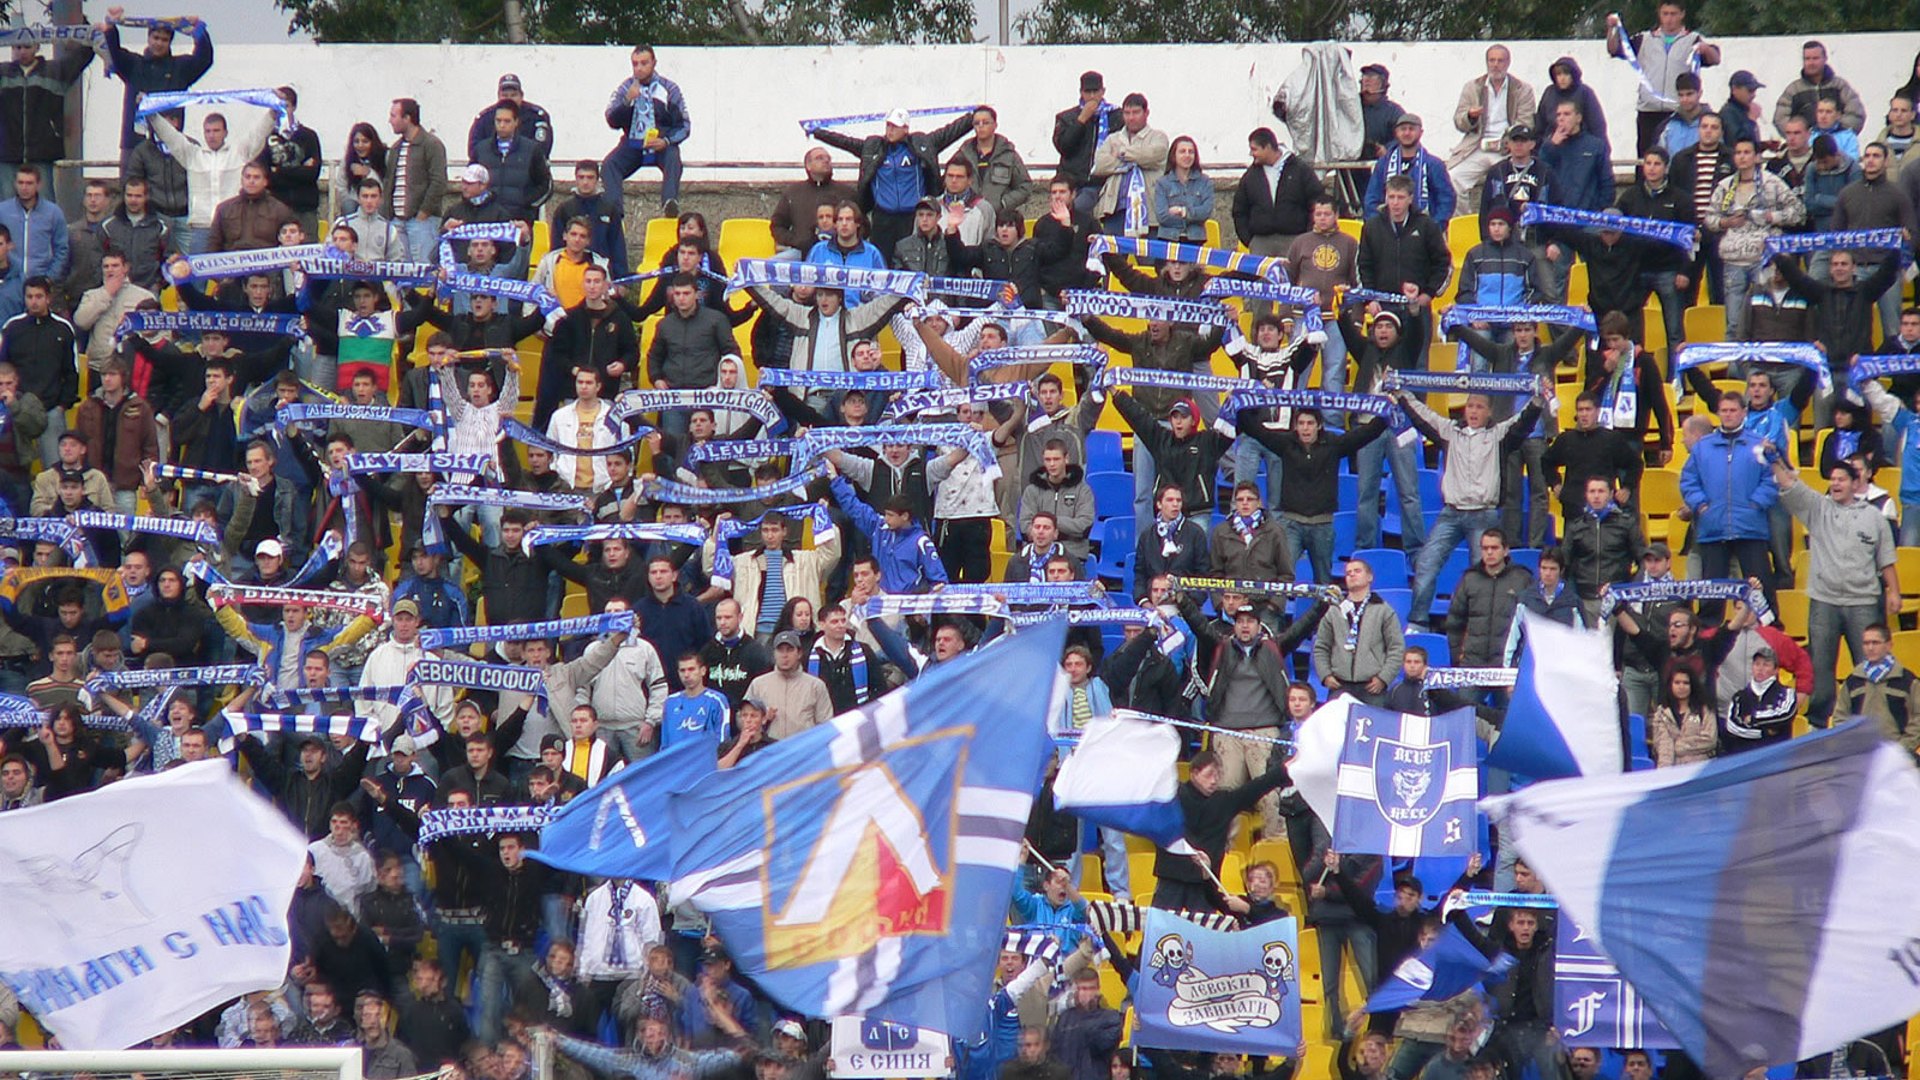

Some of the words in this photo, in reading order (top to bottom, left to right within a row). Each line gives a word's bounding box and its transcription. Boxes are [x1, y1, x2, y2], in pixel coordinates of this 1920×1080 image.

[239, 252, 270, 265] PARK
[271, 247, 323, 261] RANGERS
[943, 278, 993, 294] СОФИЯ
[865, 374, 925, 387] SOFIA
[640, 392, 682, 407] BLUE
[693, 391, 776, 425] HOOLIGANS
[709, 442, 779, 457] LEVSKI
[453, 622, 529, 640] ЛЕВСКИ
[534, 614, 600, 633] СОФИЯ
[197, 667, 239, 682] 1914
[480, 668, 541, 691] СОФИЯ
[1190, 977, 1251, 998] ЛЕВСКИ
[1183, 1003, 1268, 1025] ЗАВИНАГИ
[870, 1053, 931, 1070] СИНЯ
